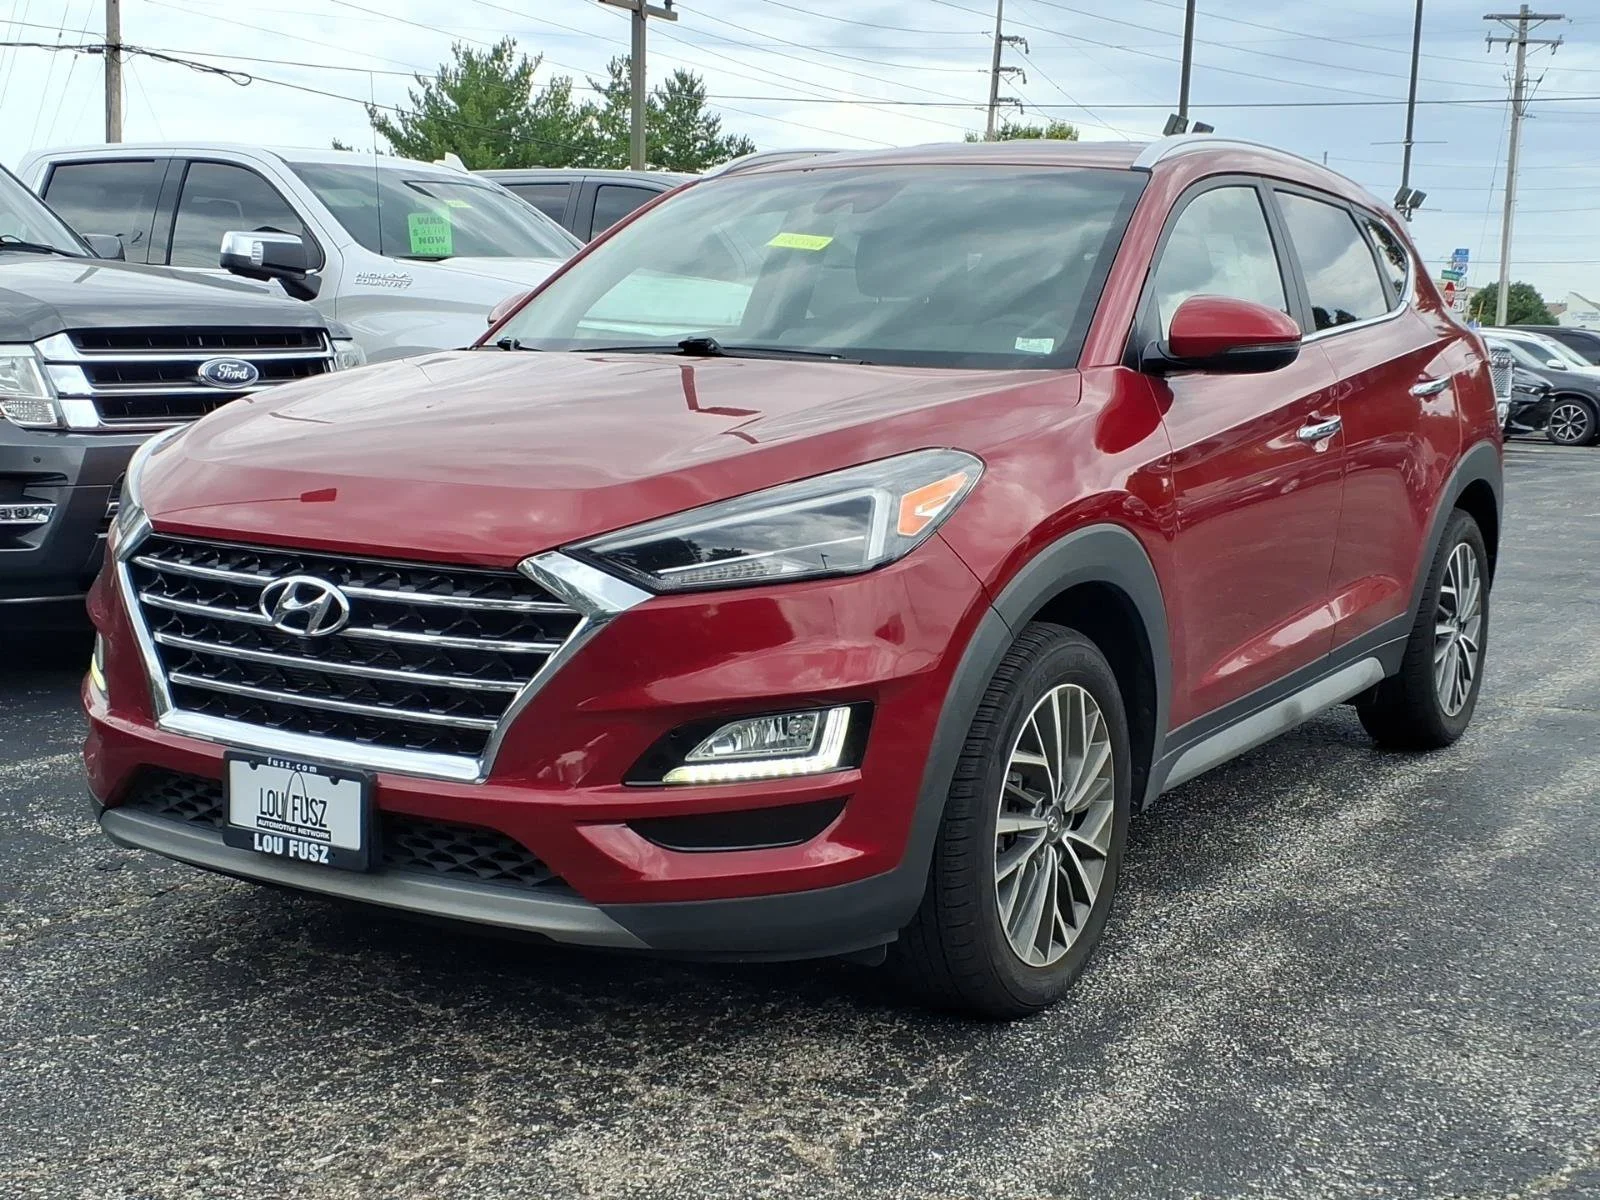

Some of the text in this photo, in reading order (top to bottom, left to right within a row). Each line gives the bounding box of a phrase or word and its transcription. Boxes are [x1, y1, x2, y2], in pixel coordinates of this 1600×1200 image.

[418, 235, 446, 245] NOW
[353, 279, 413, 289] COUNTRY
[217, 363, 249, 380] Ford
[267, 757, 318, 773] fusz.com
[260, 787, 328, 828] LOU FUSZ
[257, 818, 330, 840] AUTOMOTIVE NETWORK
[254, 832, 329, 864] LOU FUSZ
